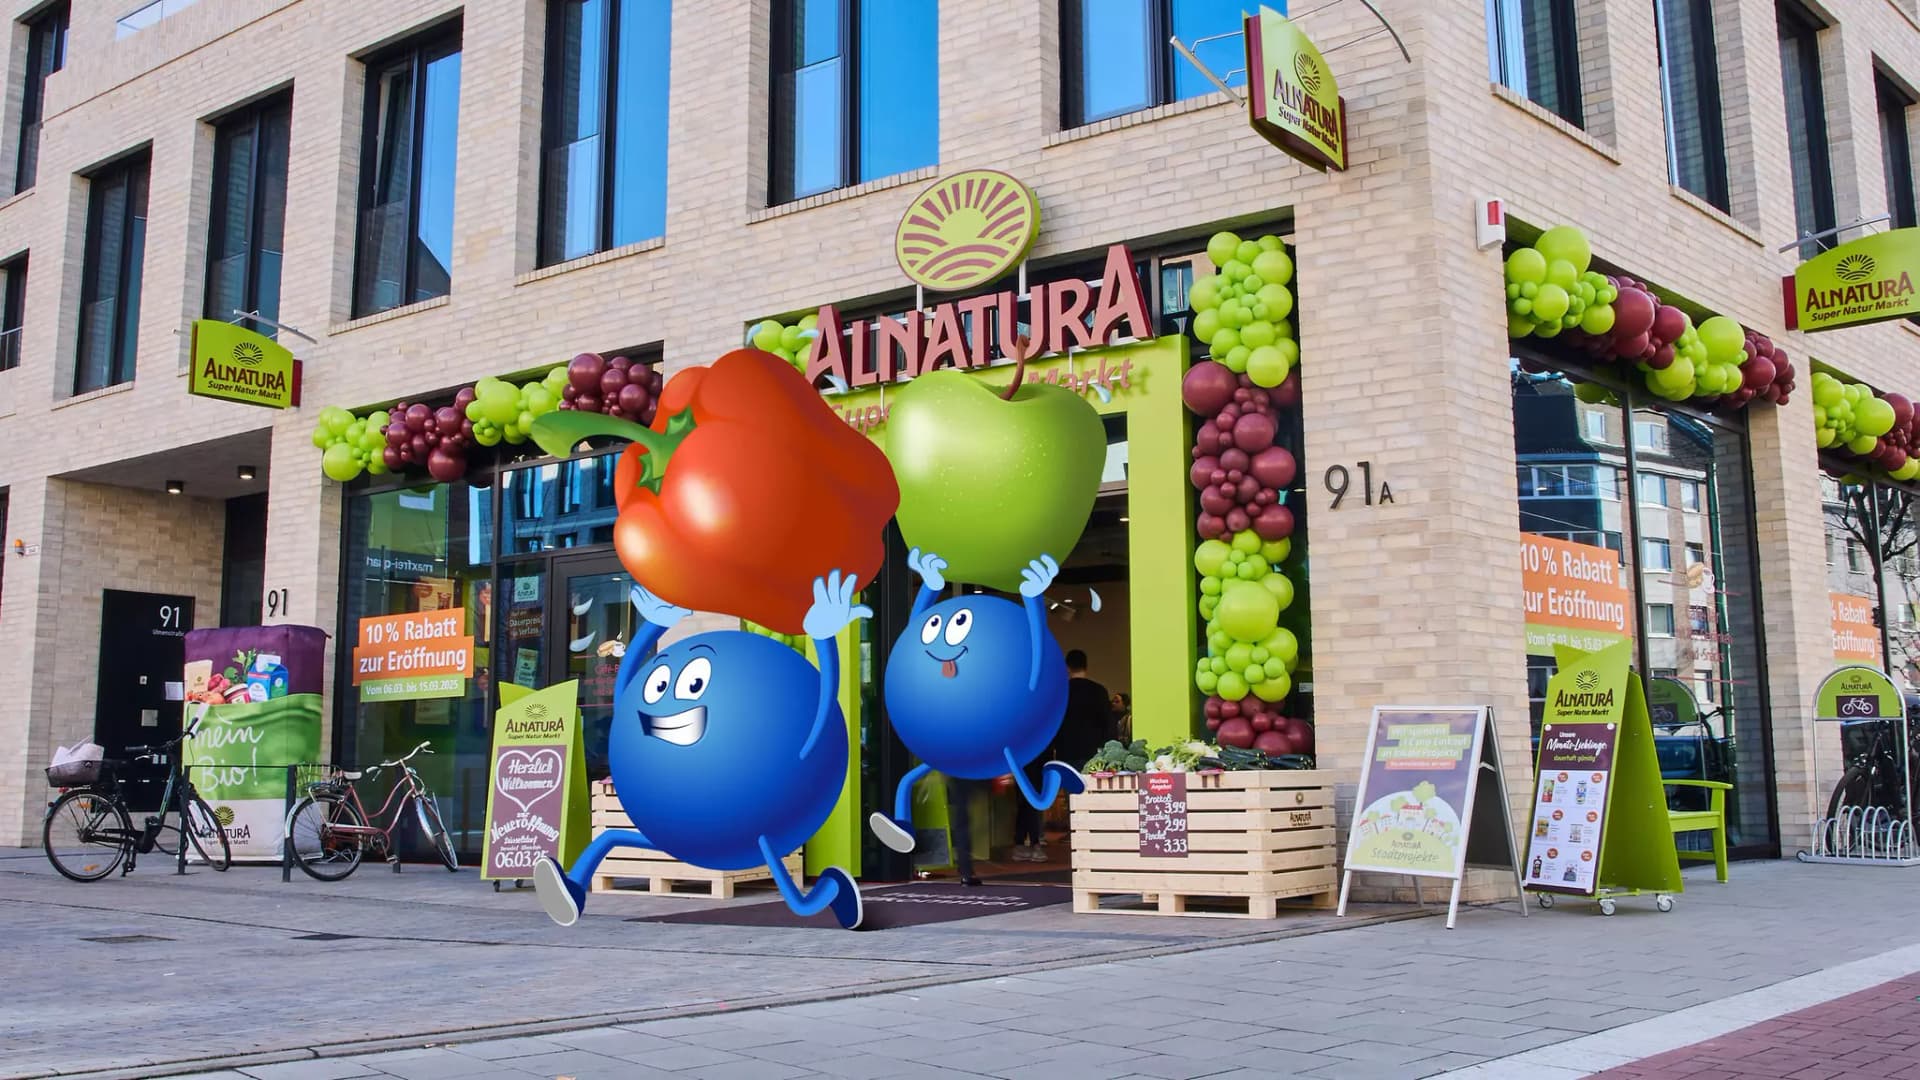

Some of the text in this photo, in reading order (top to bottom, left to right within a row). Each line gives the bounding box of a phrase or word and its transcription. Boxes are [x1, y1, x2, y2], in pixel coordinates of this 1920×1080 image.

[1273, 69, 1340, 143] ALNATURA
[1278, 105, 1301, 126] Super
[1805, 271, 1915, 312] ALNATURA
[805, 244, 1154, 387] ALNATURA
[1811, 298, 1909, 321] Super Natur Markt
[203, 357, 286, 393] ALNATURA
[207, 380, 282, 400] Super Natur Markt
[1520, 543, 1614, 585] 10 % Rabatt
[267, 588, 288, 617] 91
[1548, 586, 1625, 630] Eröffnung
[1839, 601, 1868, 625] Rabatt
[160, 605, 180, 628] 91
[366, 617, 457, 644] 10 % Rabatt
[1527, 631, 1545, 645] Vom
[1832, 629, 1875, 659] Eröffnung
[360, 647, 467, 673] zur Eröffnung
[365, 685, 382, 695] Vom
[406, 681, 417, 692] bis
[1555, 688, 1613, 707] ALNATURA
[194, 713, 264, 748] mein
[505, 717, 565, 733] ALNATURA
[507, 757, 554, 775] Herzlich
[502, 776, 554, 790] Willkommen
[491, 815, 560, 844] Neueröffnung
